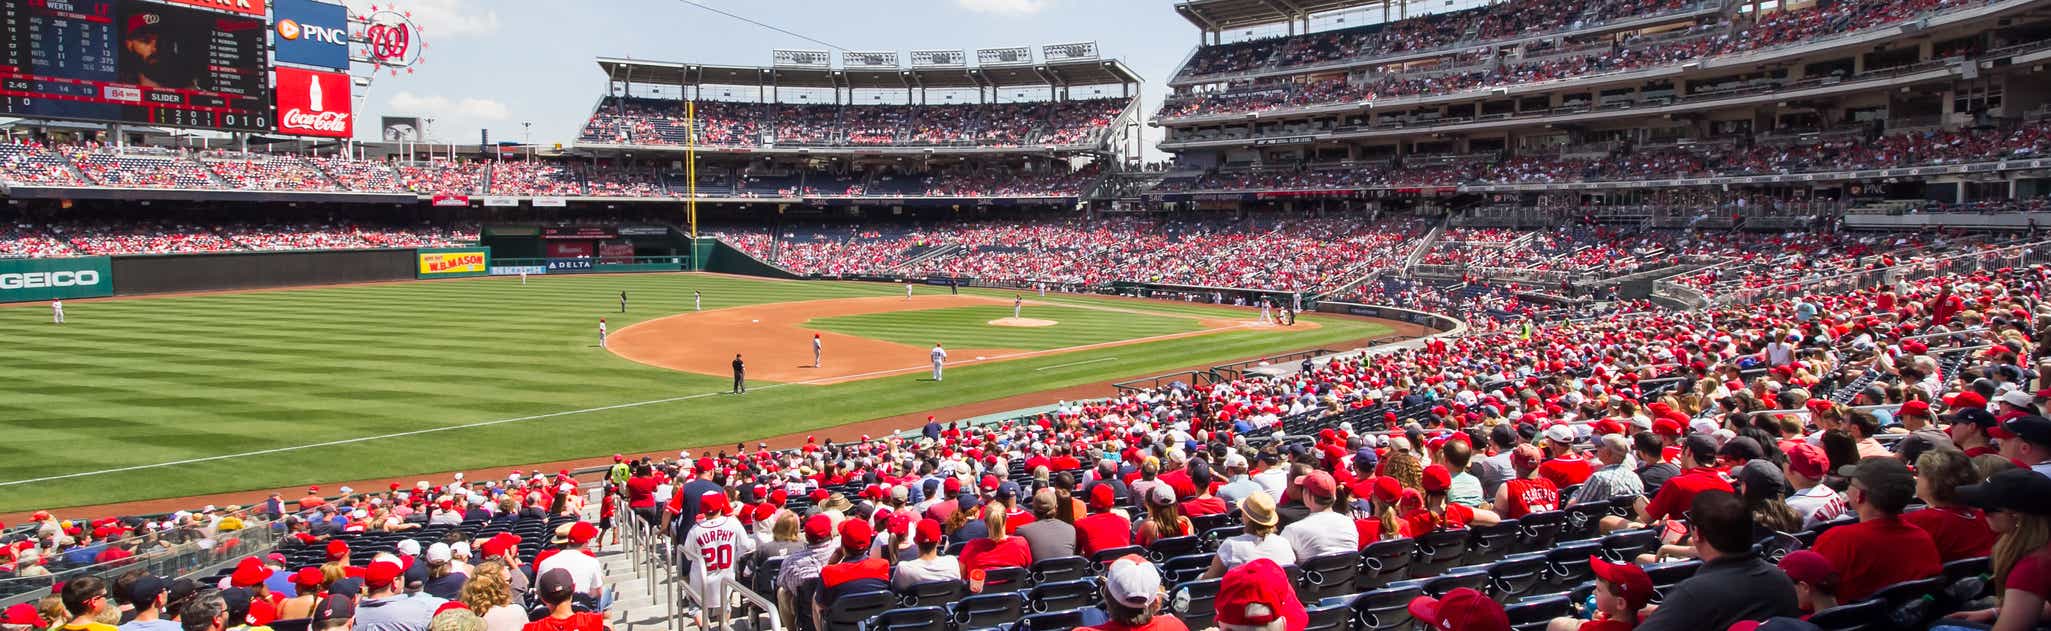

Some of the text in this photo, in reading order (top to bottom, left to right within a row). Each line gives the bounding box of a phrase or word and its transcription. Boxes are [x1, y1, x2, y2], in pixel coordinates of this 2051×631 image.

[47, 1, 74, 11] WERTH
[300, 24, 346, 44] PNC
[112, 89, 124, 98] 84
[152, 93, 180, 102] SLIDER
[24, 98, 30, 106] 0
[191, 110, 196, 118] 0
[191, 118, 197, 126] 0
[226, 114, 264, 128] 0 1 0
[284, 108, 349, 132] Coca-Cola
[1863, 183, 1888, 194] PNC
[0, 270, 100, 290] GEICO
[696, 530, 735, 547] MURPHY
[701, 544, 732, 572] 20
